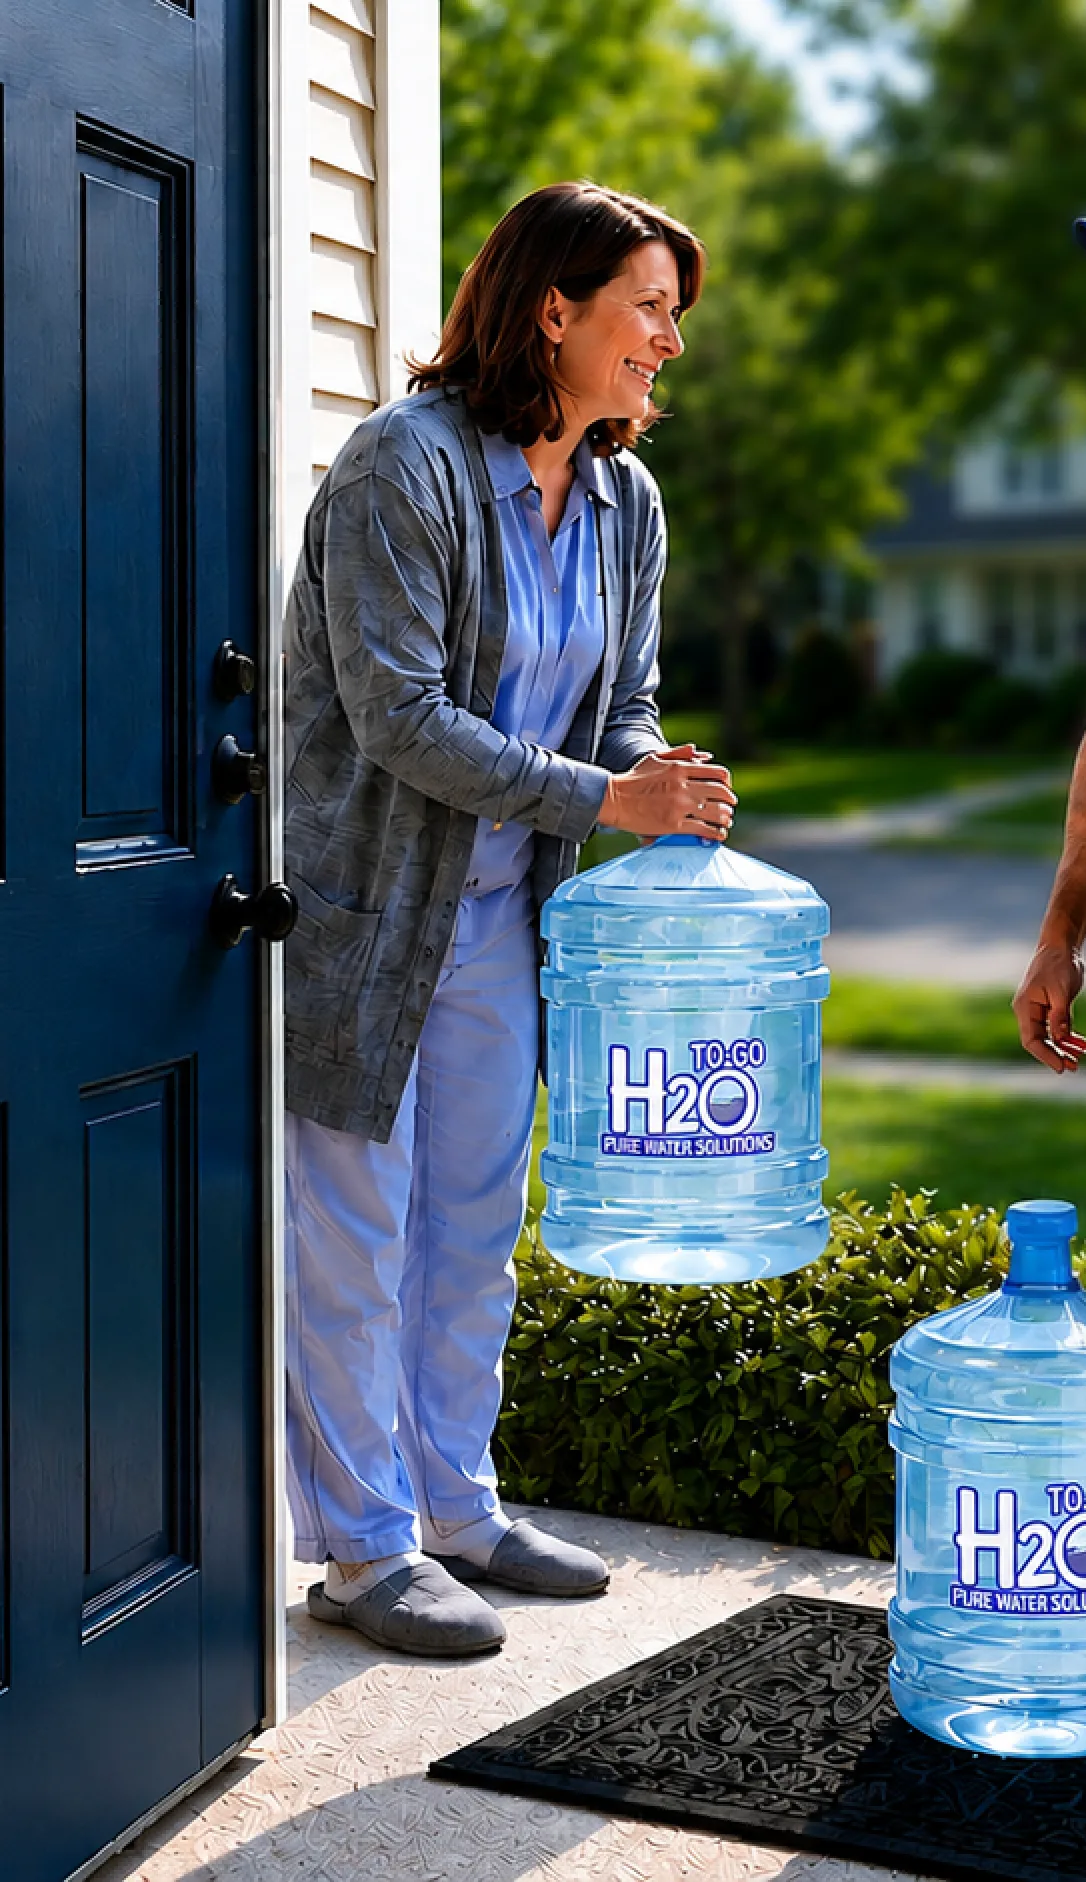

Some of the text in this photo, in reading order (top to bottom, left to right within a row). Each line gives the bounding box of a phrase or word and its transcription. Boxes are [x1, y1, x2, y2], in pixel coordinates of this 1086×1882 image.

[688, 1038, 766, 1071] TO-GO
[608, 1044, 759, 1135] H2O
[695, 1134, 774, 1155] SOLUTIONS
[953, 1587, 993, 1609] PURE
[995, 1591, 1048, 1612] WATER
